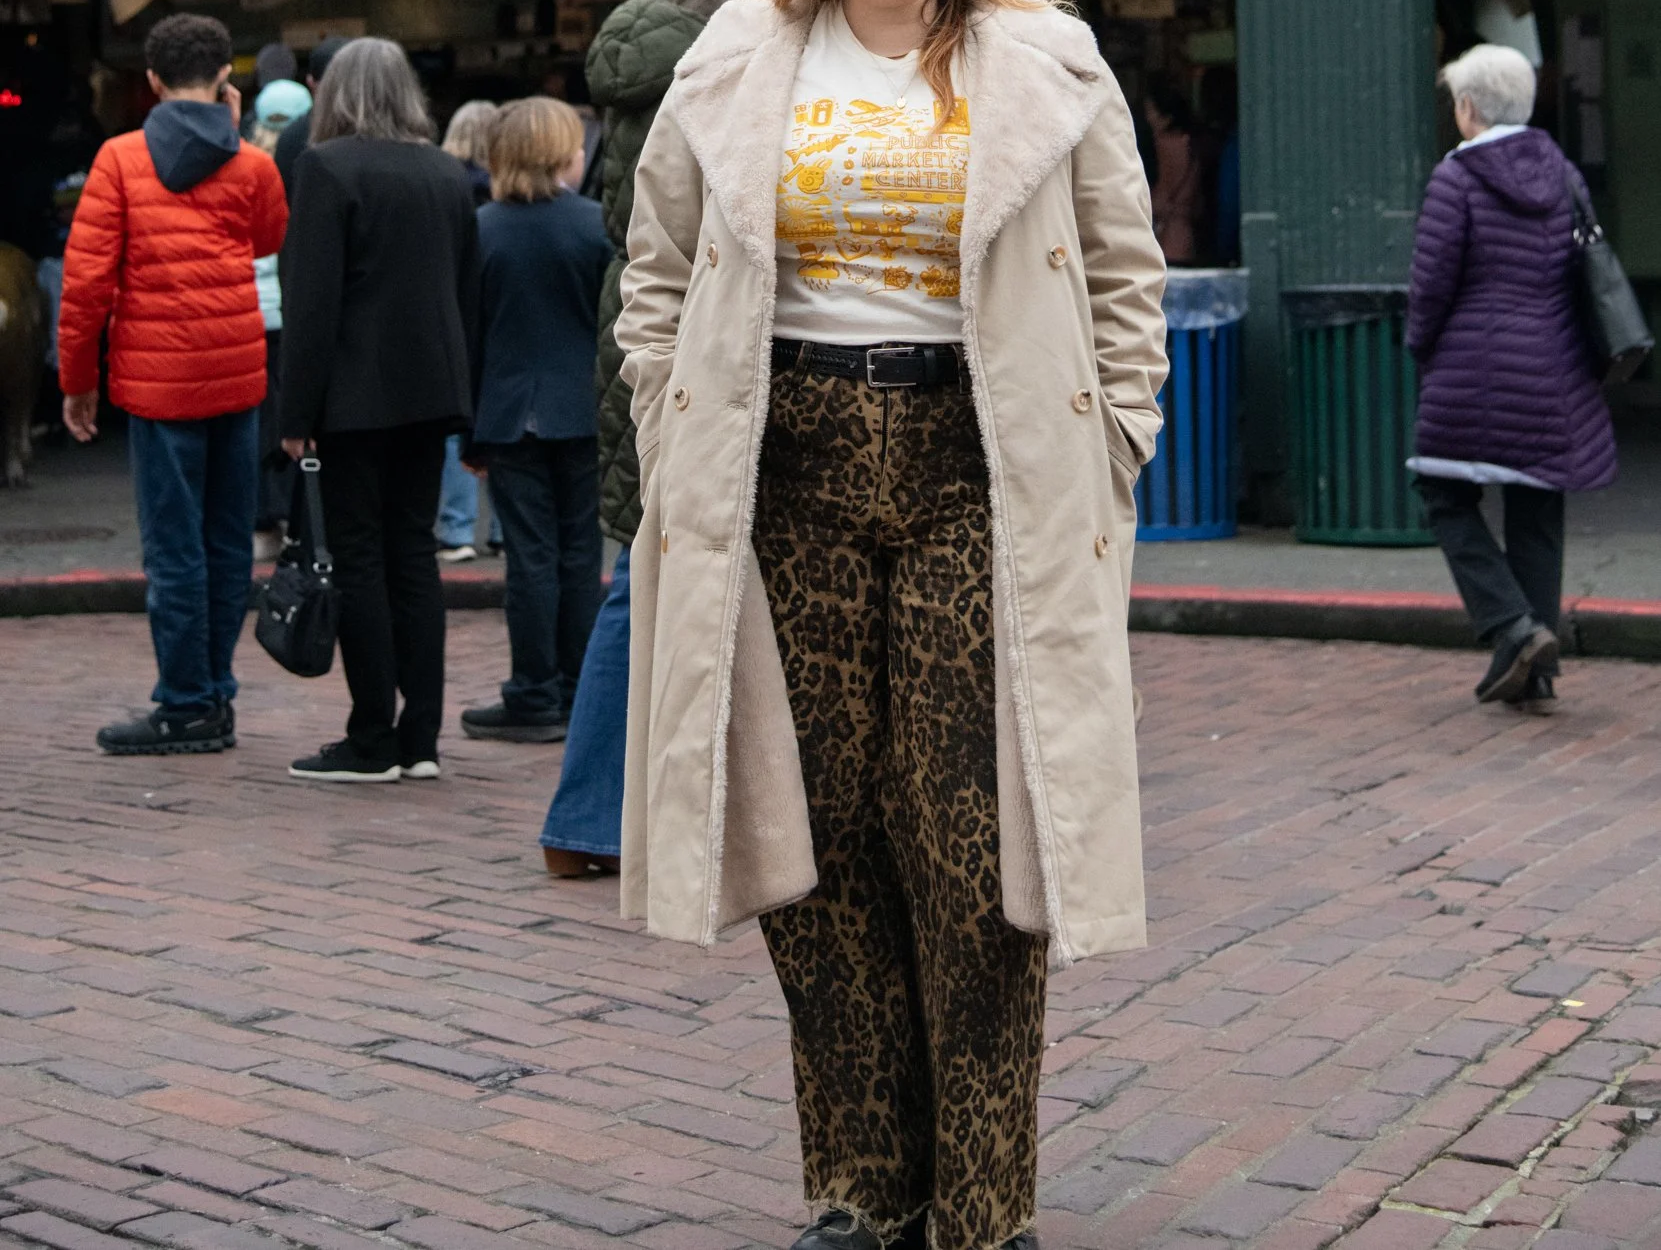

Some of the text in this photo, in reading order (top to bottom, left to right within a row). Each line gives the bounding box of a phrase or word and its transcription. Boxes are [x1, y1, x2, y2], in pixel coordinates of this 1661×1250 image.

[888, 135, 960, 150] PUBLIC
[861, 151, 946, 168] MARKET
[875, 169, 965, 190] CENTER
